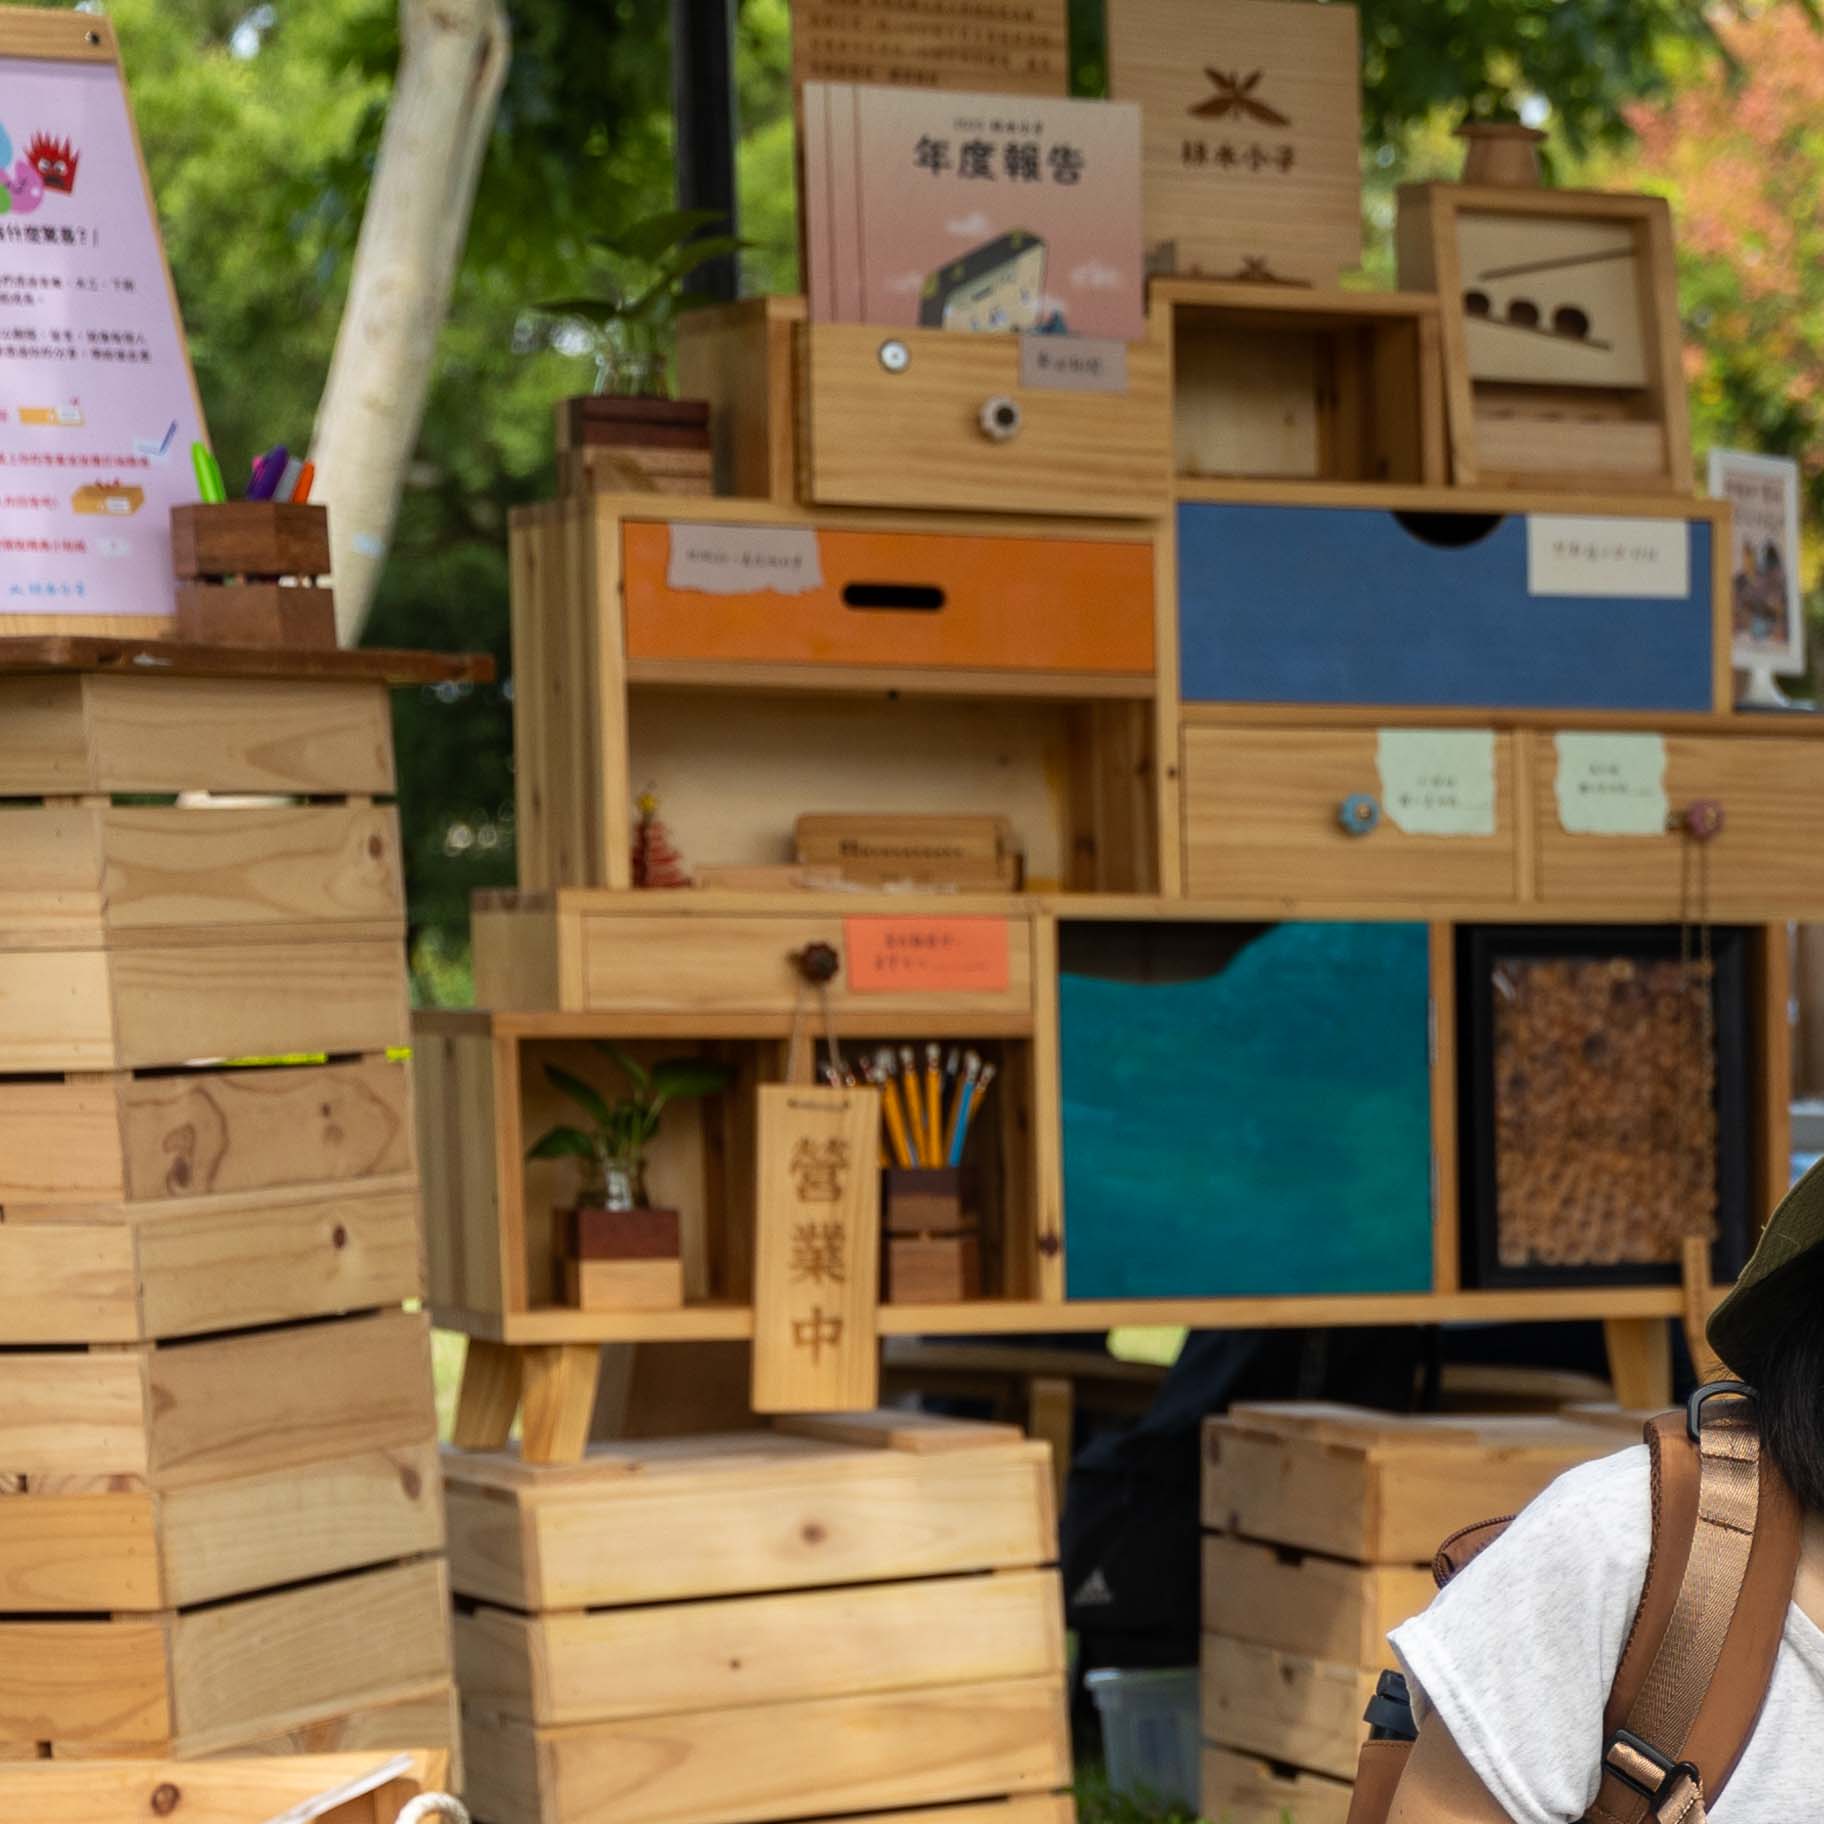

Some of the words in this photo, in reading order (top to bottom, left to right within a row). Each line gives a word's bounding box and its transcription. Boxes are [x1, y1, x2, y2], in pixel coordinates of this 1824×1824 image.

[913, 134, 1088, 187] 年度報告
[788, 1135, 847, 1367] 營業中
